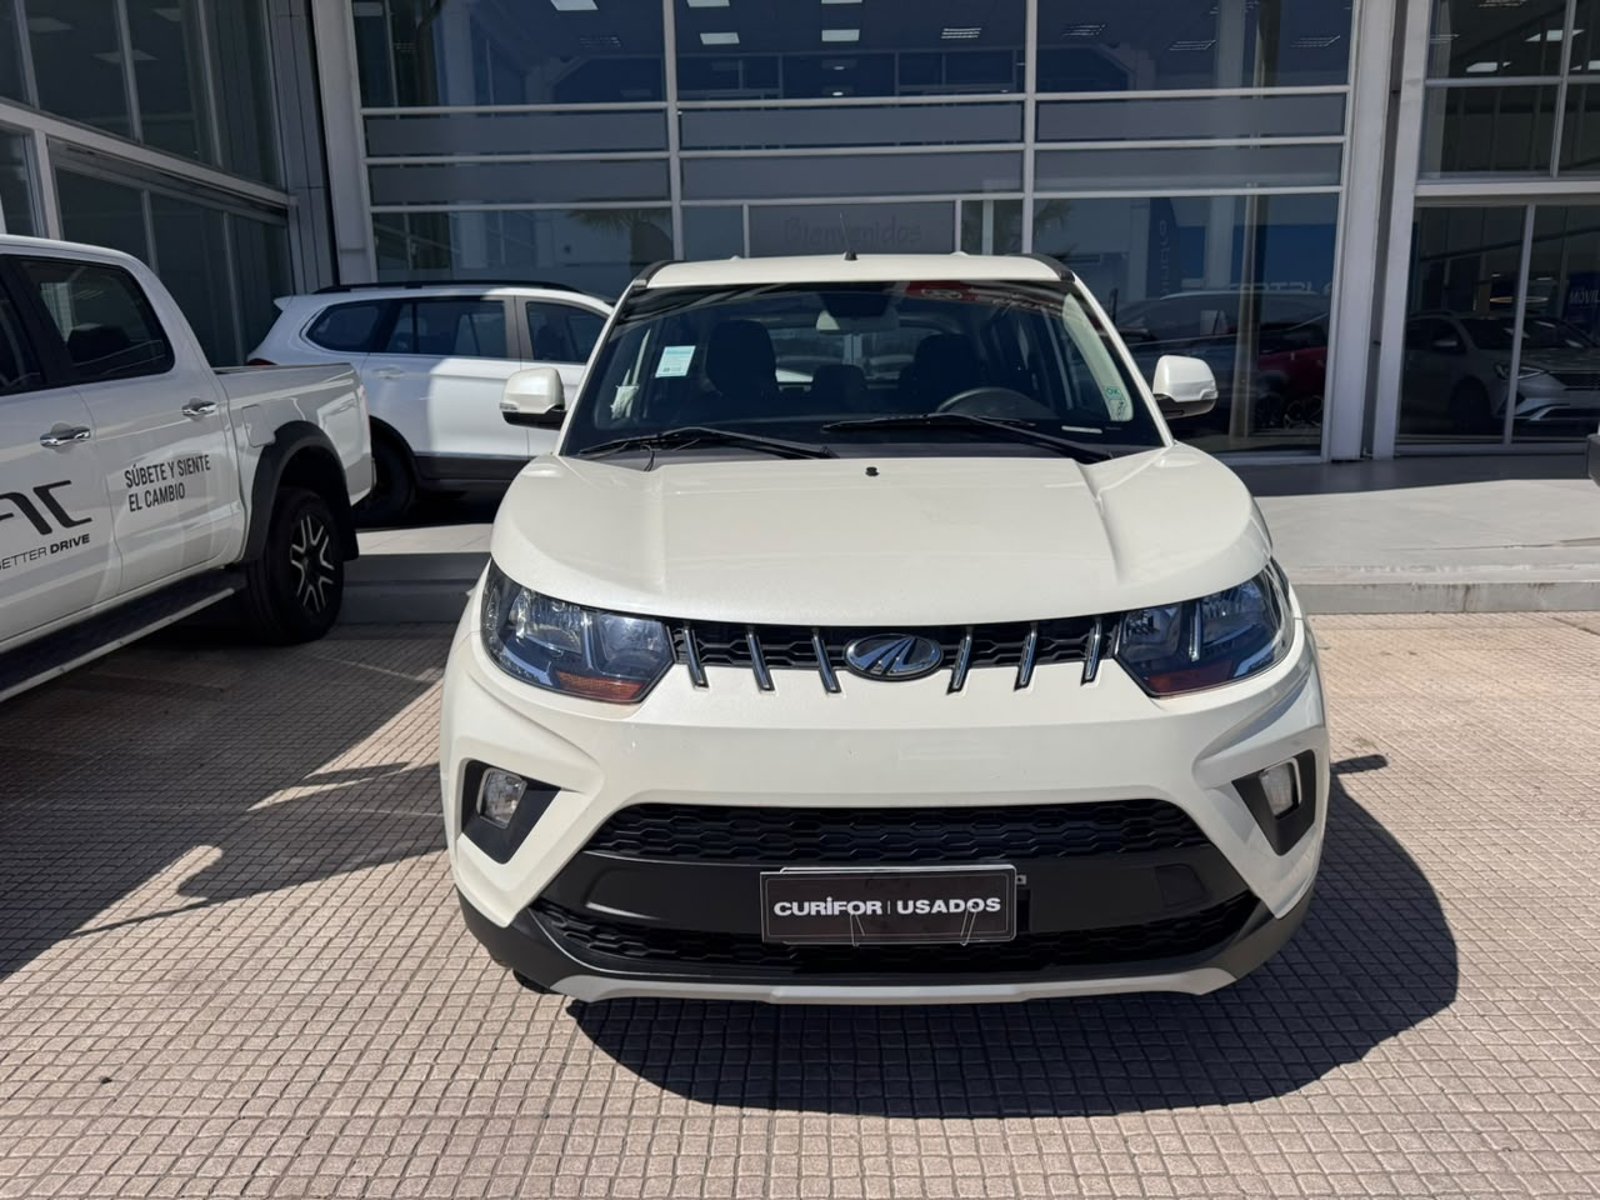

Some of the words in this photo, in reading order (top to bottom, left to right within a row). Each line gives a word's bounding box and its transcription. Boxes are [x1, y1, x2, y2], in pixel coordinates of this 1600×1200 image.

[124, 463, 167, 488] SÚBETE
[168, 461, 175, 478] Y
[177, 454, 211, 477] SIENTE
[128, 493, 143, 512] EL
[144, 482, 186, 508] CAMBIO
[50, 533, 90, 554] DRIVE
[897, 897, 1001, 915] USADOS
